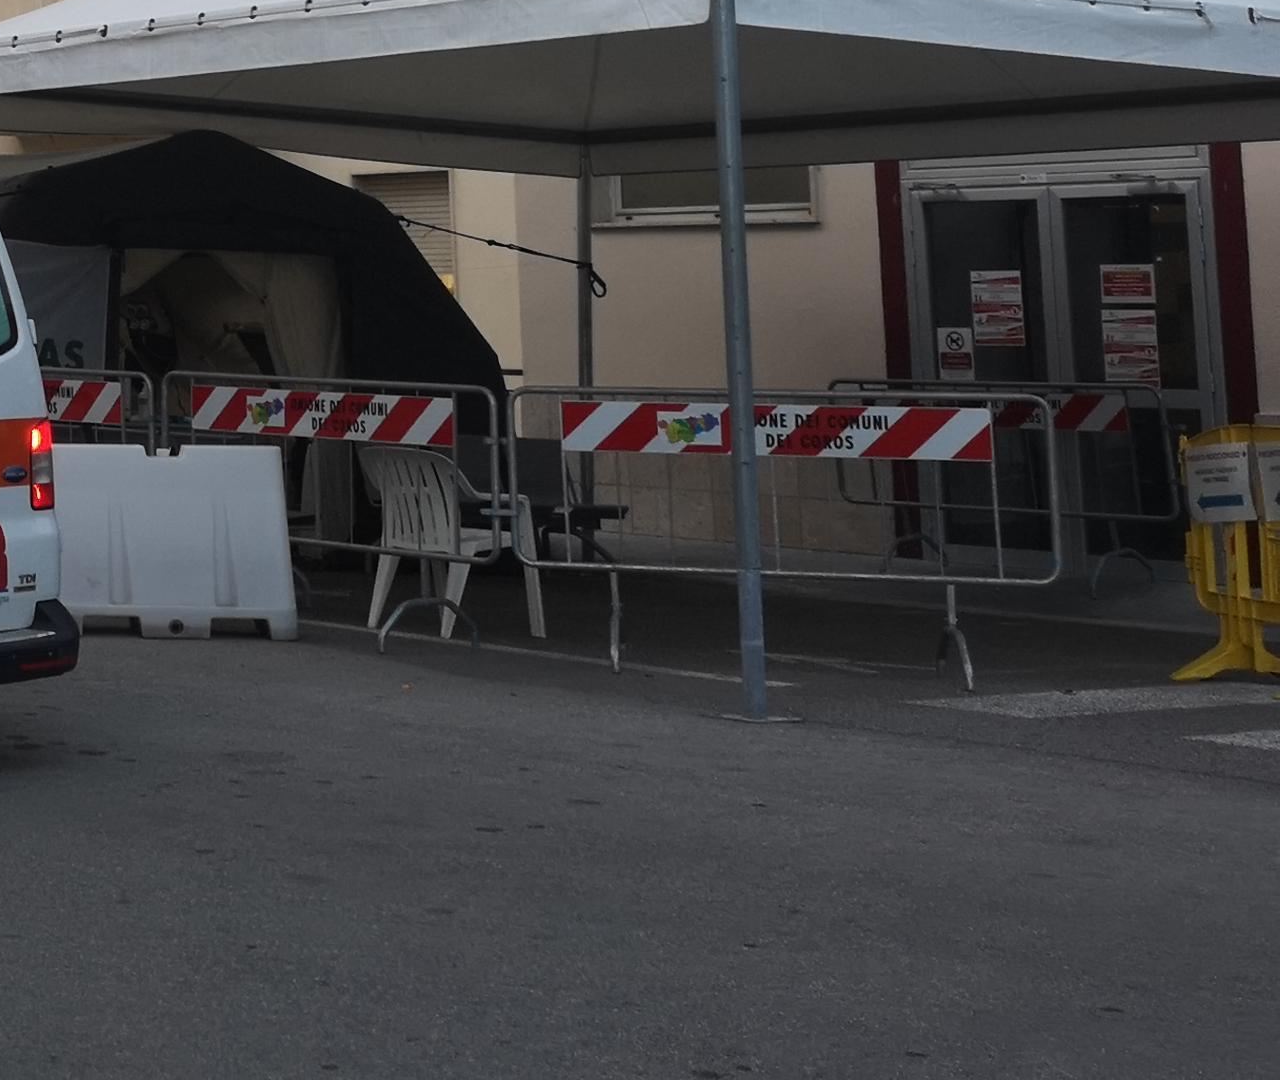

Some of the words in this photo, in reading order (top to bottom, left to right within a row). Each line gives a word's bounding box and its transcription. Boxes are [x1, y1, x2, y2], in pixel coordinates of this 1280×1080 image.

[794, 413, 820, 429] DEI
[827, 415, 889, 431] COMUNI
[765, 433, 793, 449] DEI
[799, 434, 855, 450] COROS
[18, 573, 37, 585] TDI
